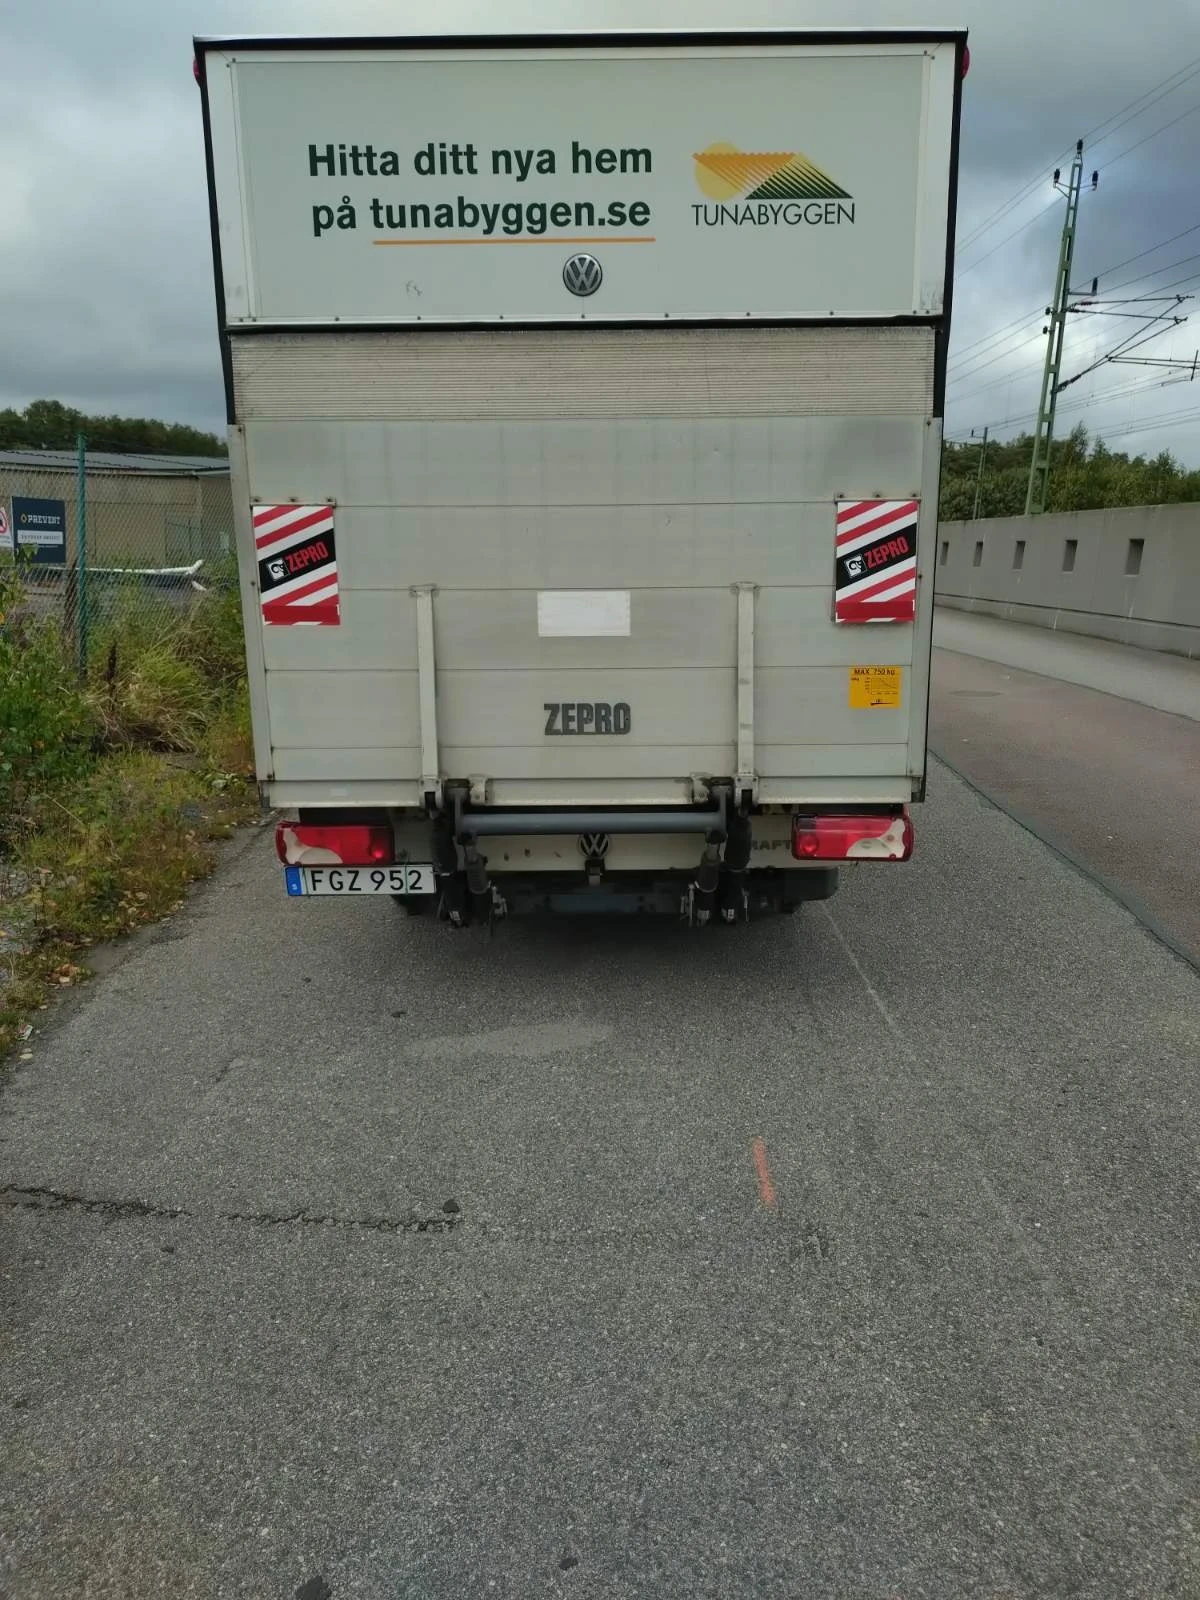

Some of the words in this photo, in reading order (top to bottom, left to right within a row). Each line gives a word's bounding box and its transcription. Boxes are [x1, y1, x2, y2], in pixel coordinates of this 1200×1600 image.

[308, 144, 400, 177] Hitta
[414, 142, 479, 176] ditt
[491, 147, 556, 182] nya
[571, 141, 652, 173] hem
[312, 195, 357, 237] på
[370, 196, 651, 235] tunabyggen.se
[691, 203, 856, 226] TUNABYGGEN
[285, 541, 329, 573] ZEPRO
[864, 536, 910, 569] ZEPRO
[543, 702, 632, 736] ZEPRO
[310, 870, 362, 891] FGZ
[370, 869, 423, 891] 952
